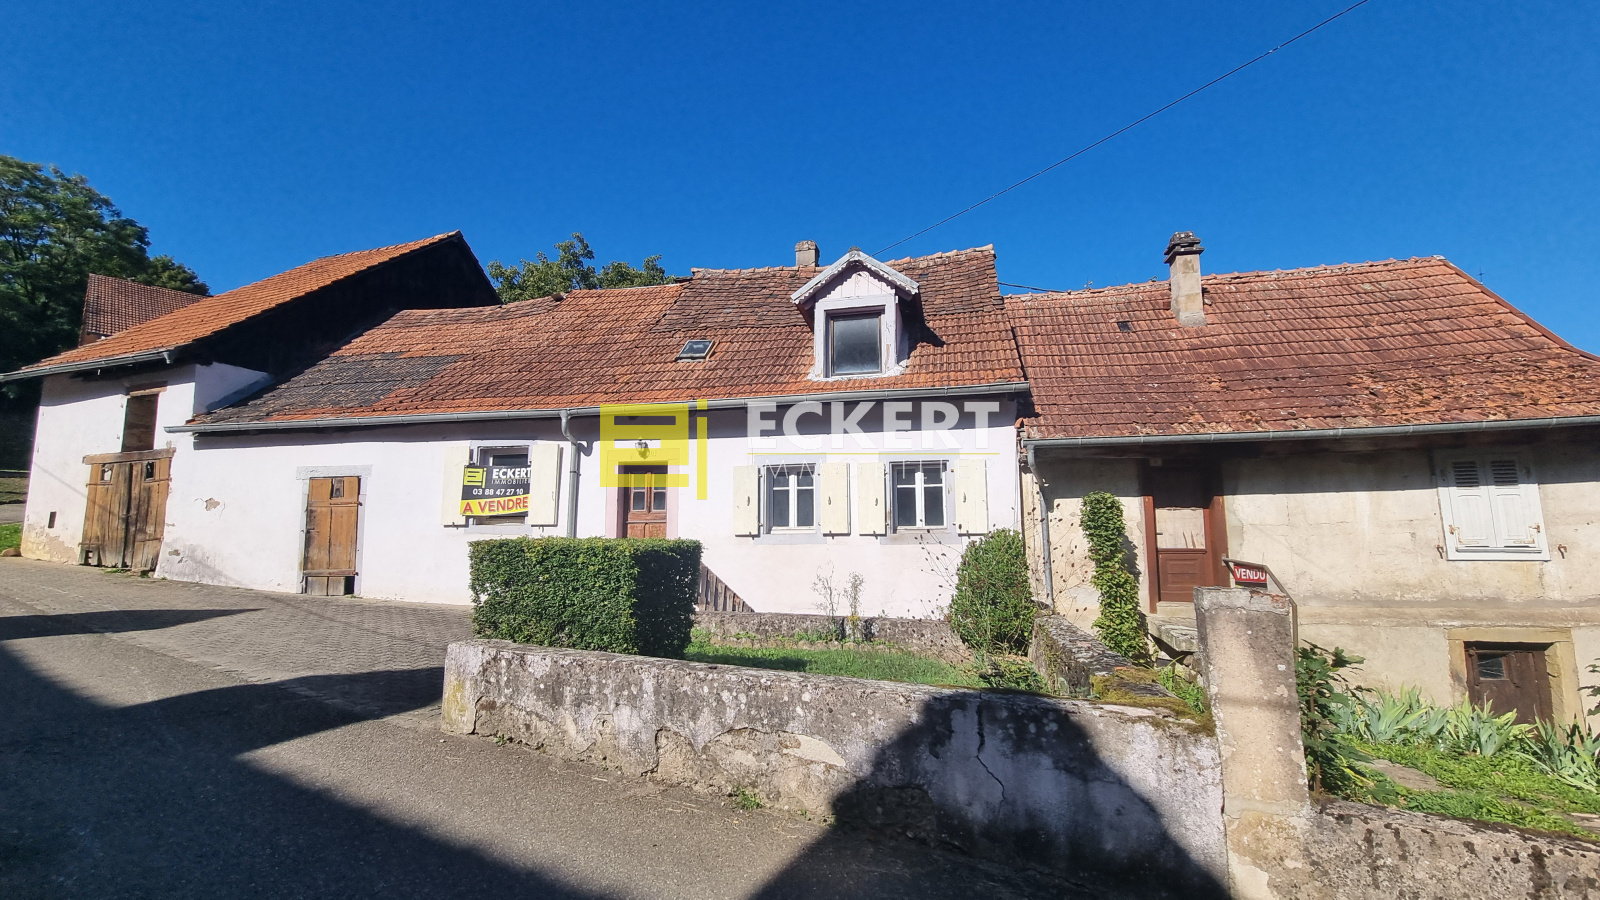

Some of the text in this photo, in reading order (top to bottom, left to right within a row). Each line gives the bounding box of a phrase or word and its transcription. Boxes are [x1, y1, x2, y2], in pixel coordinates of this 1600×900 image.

[492, 468, 531, 479] ECKERT
[463, 497, 528, 513] A VENDRE
[1235, 568, 1266, 580] VENDU
